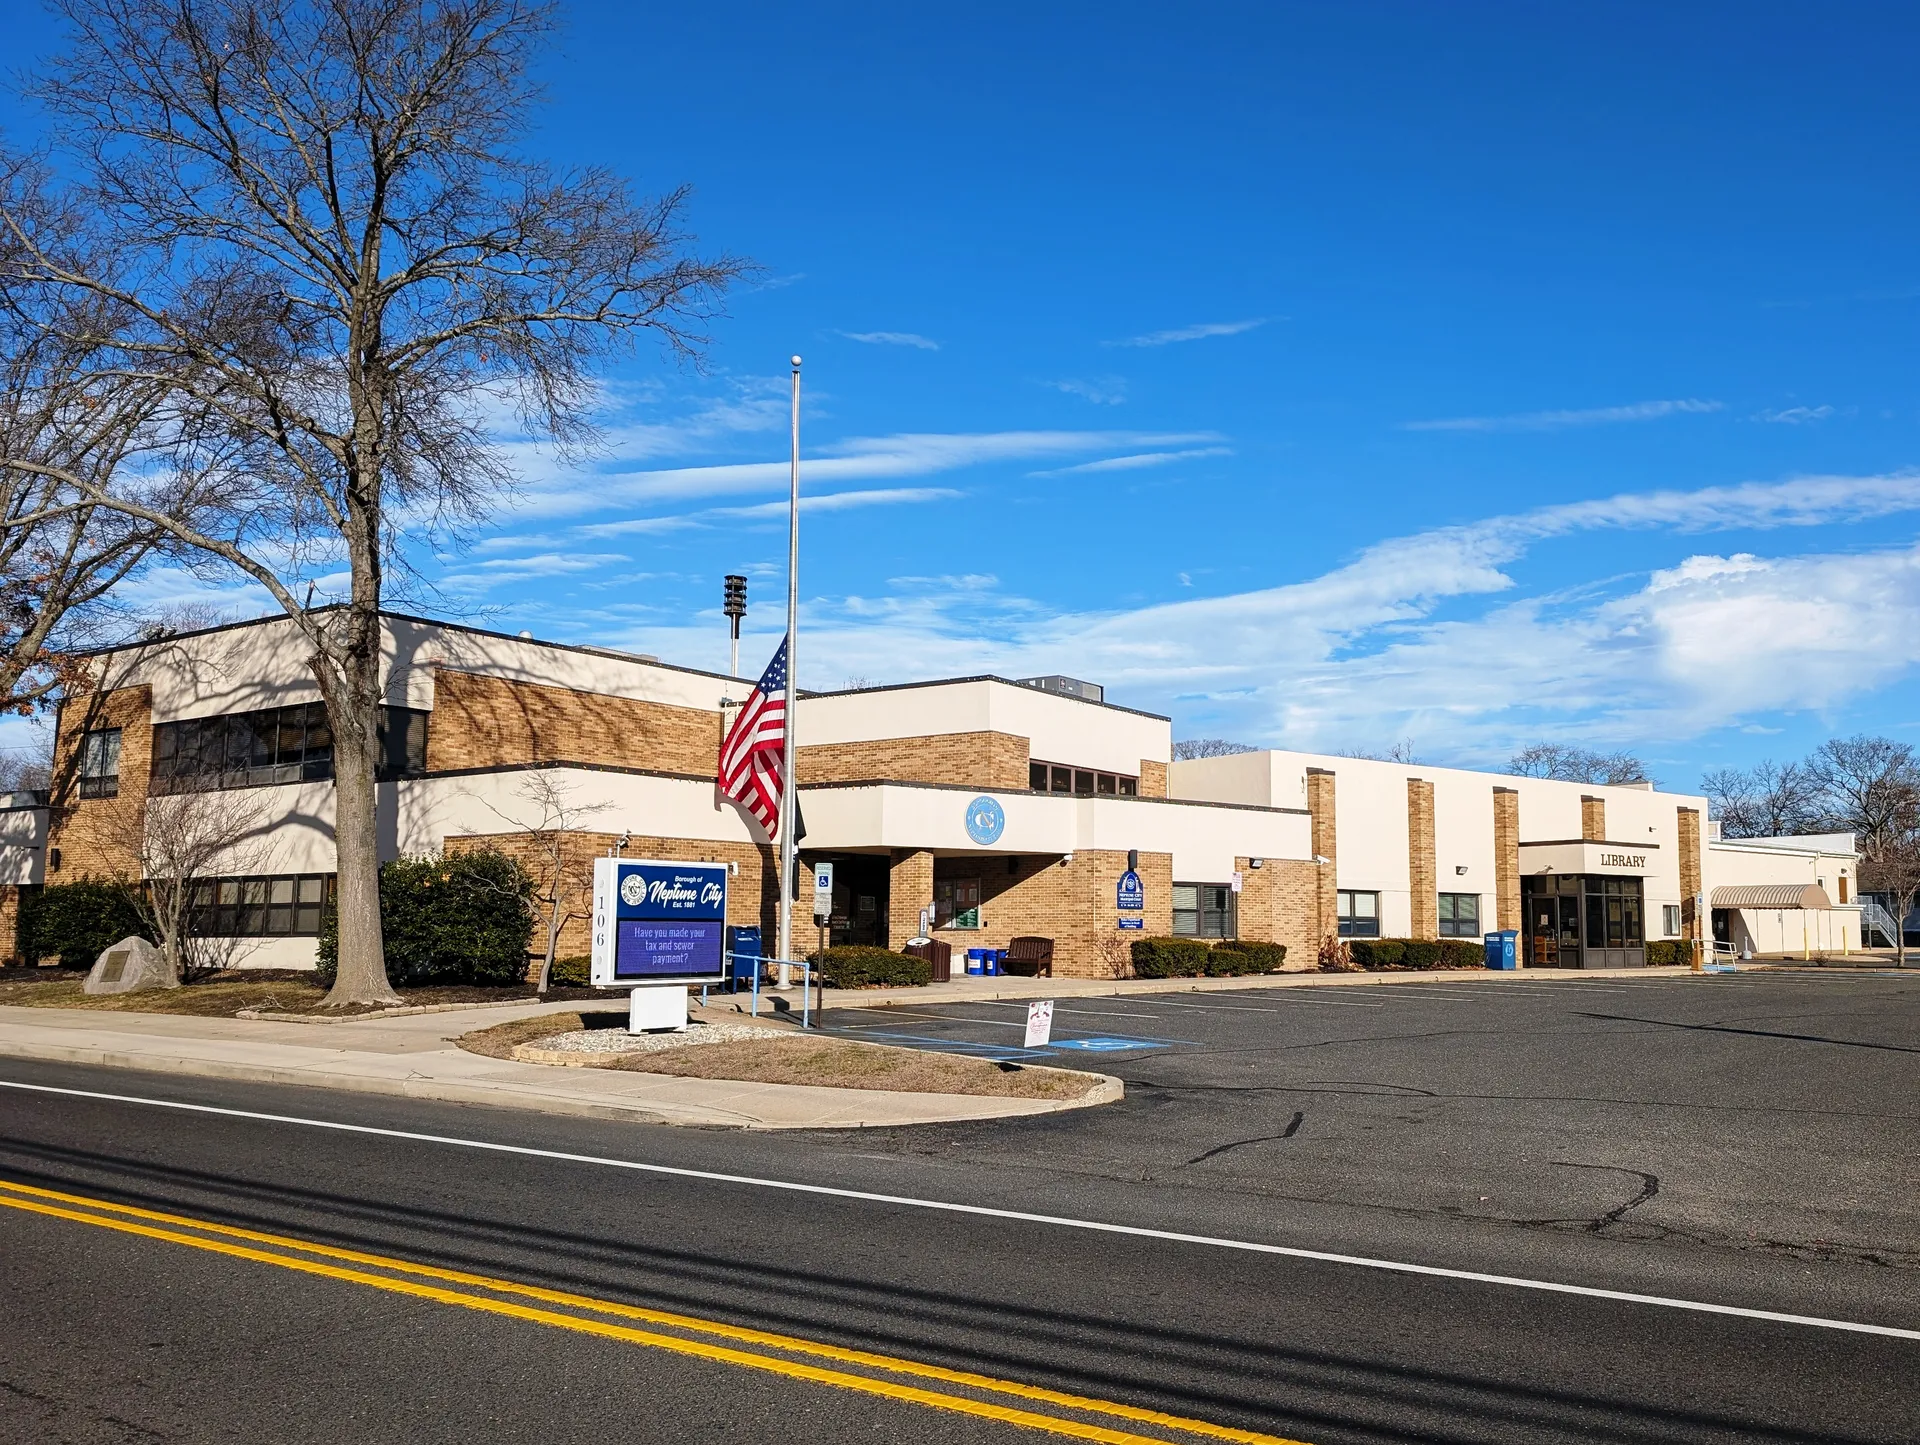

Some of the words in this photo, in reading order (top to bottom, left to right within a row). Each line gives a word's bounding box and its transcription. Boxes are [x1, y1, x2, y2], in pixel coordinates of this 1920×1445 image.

[1600, 853, 1646, 868] LIBRARY
[675, 875, 697, 883] Borough
[648, 880, 697, 908] Neptune
[700, 882, 723, 909] City
[597, 896, 605, 946] 106
[634, 927, 653, 938] Have
[654, 930, 667, 938] you
[668, 927, 689, 938] made
[689, 929, 706, 939] your
[645, 940, 658, 951] tax
[658, 940, 672, 951] and
[673, 942, 695, 950] sewer
[652, 953, 689, 966] payment?
